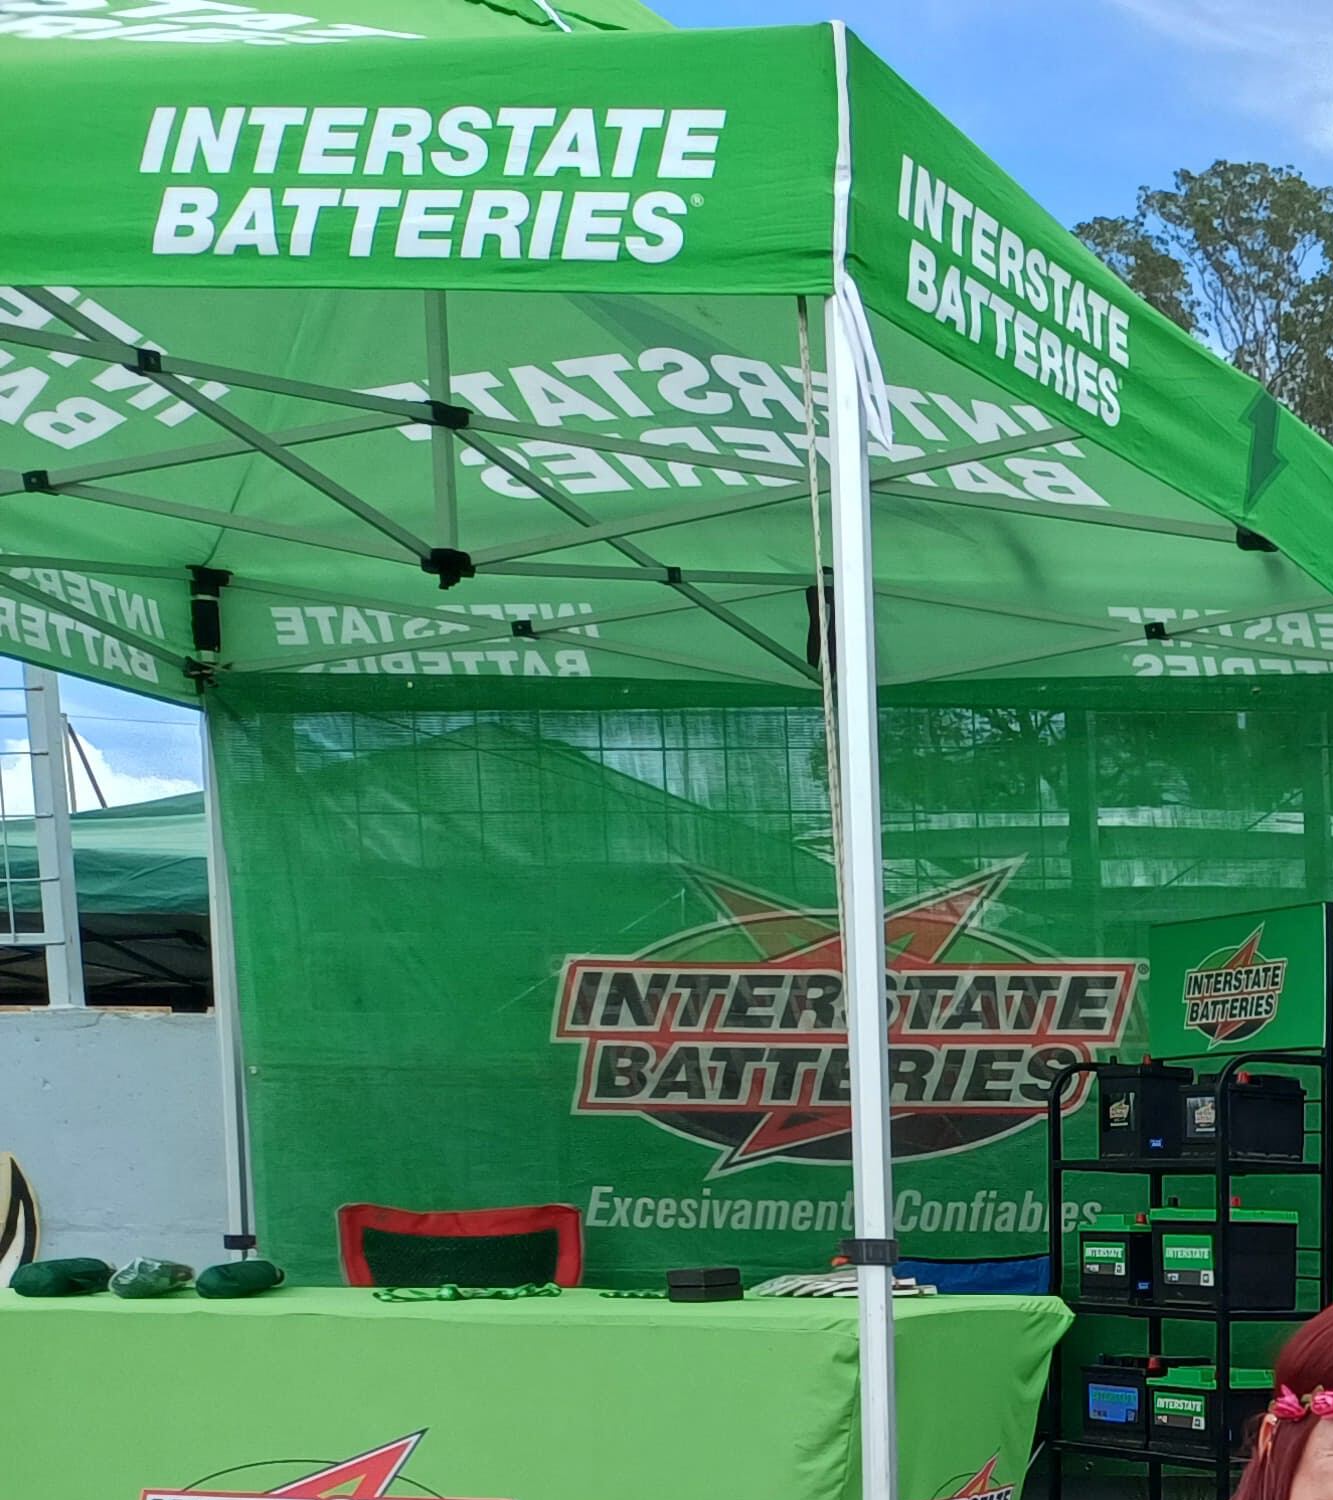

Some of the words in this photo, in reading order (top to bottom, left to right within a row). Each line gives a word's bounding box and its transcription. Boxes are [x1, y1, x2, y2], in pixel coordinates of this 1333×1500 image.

[139, 106, 727, 178] INTERSTATE
[899, 154, 1129, 368] INTERSTATE
[907, 239, 1121, 426] BATTERIES
[1187, 966, 1282, 996] INTERSTATE
[1189, 994, 1275, 1022] BATTERIES
[586, 1186, 855, 1231] Excesivament
[1157, 1397, 1202, 1412] INTERSTATE
